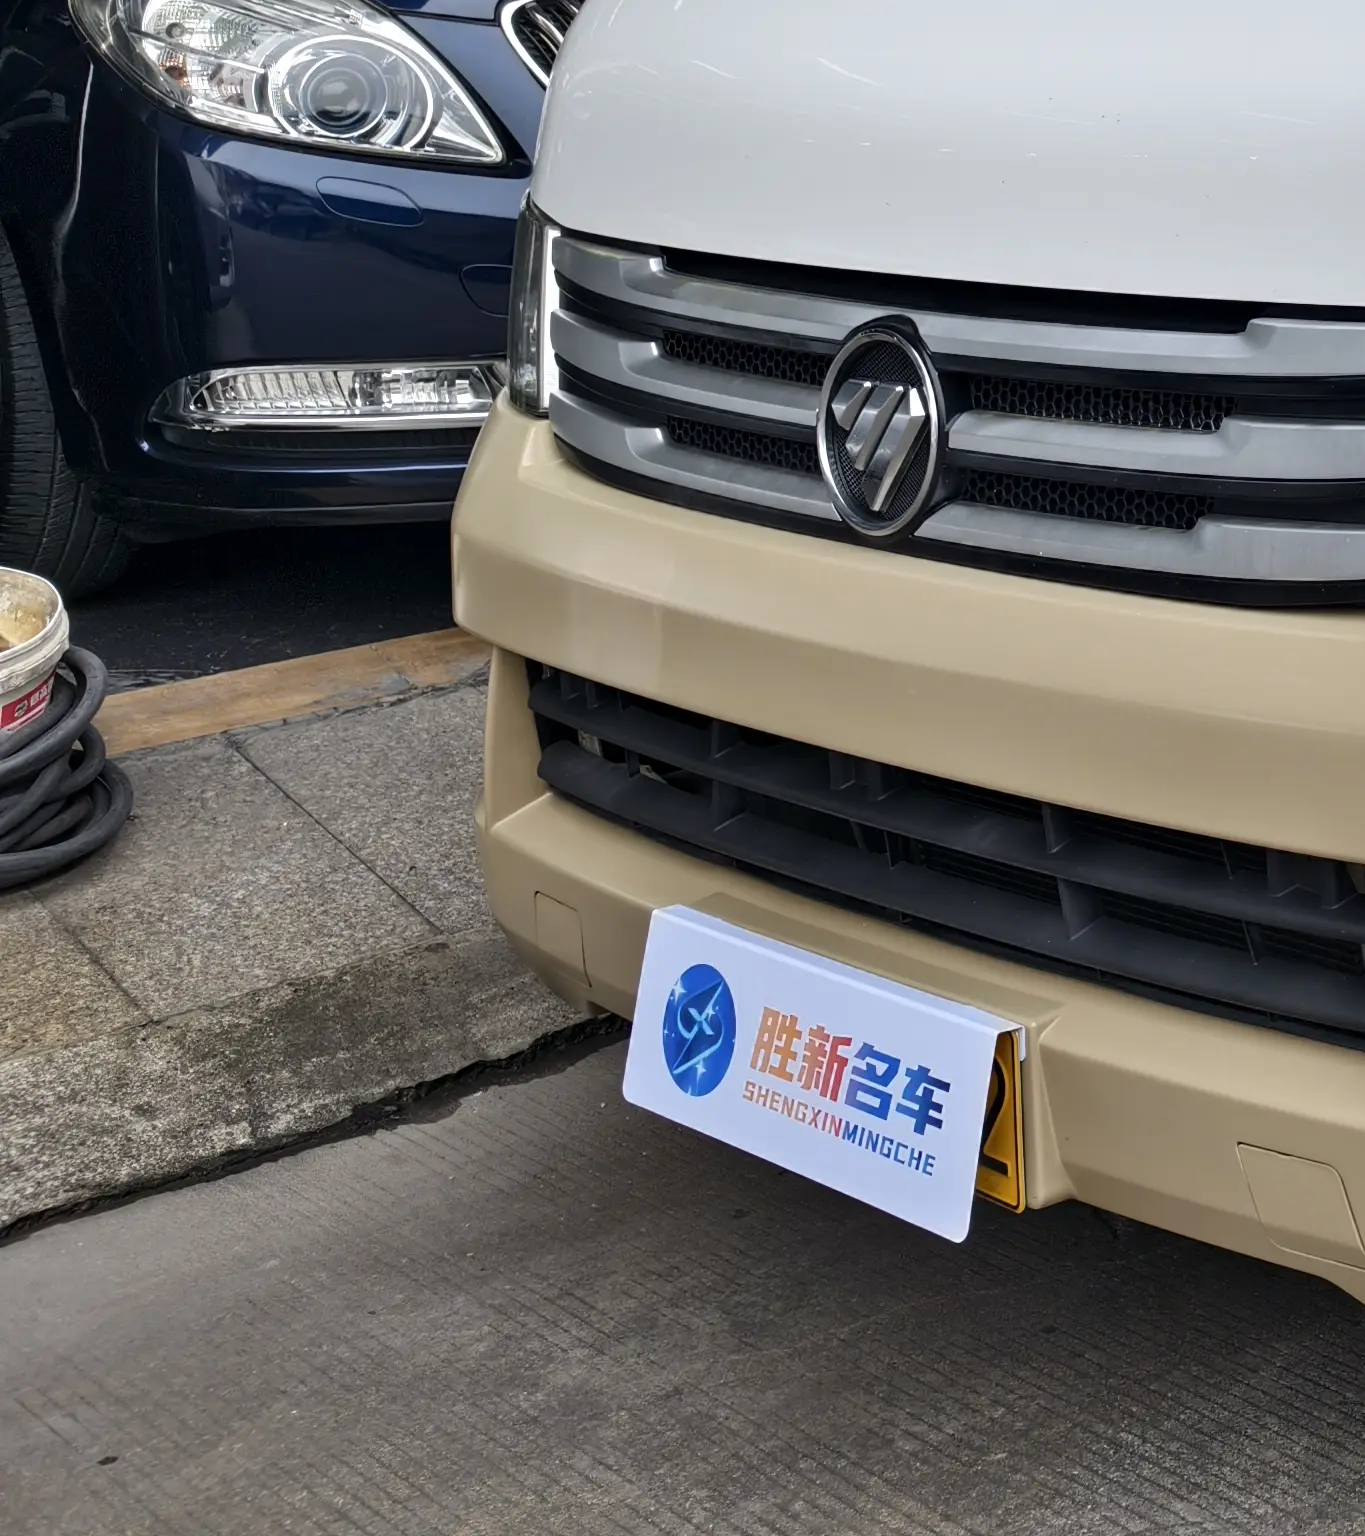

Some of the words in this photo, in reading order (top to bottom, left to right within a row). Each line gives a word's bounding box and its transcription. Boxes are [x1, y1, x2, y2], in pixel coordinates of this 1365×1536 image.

[749, 1006, 952, 1136] 胜新名车
[742, 1080, 937, 1177] SHENGXINMINGCHE
